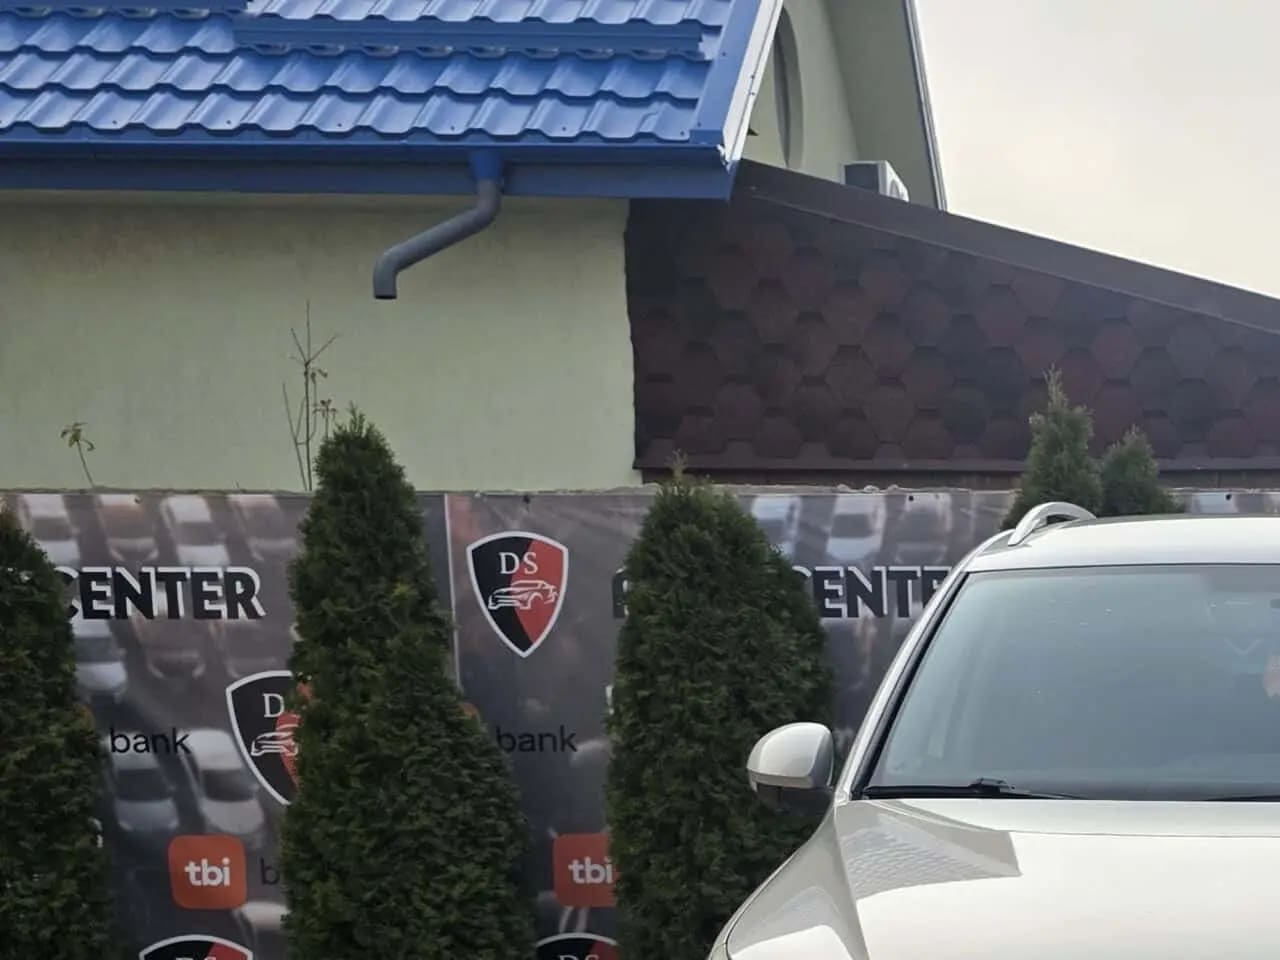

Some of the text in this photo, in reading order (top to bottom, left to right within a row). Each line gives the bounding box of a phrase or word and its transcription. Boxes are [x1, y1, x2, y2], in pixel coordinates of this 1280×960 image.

[499, 551, 539, 575] DS
[263, 693, 285, 718] D
[109, 727, 192, 754] bank
[496, 725, 577, 753] bank
[184, 857, 231, 887] tbi
[568, 856, 614, 885] tbi
